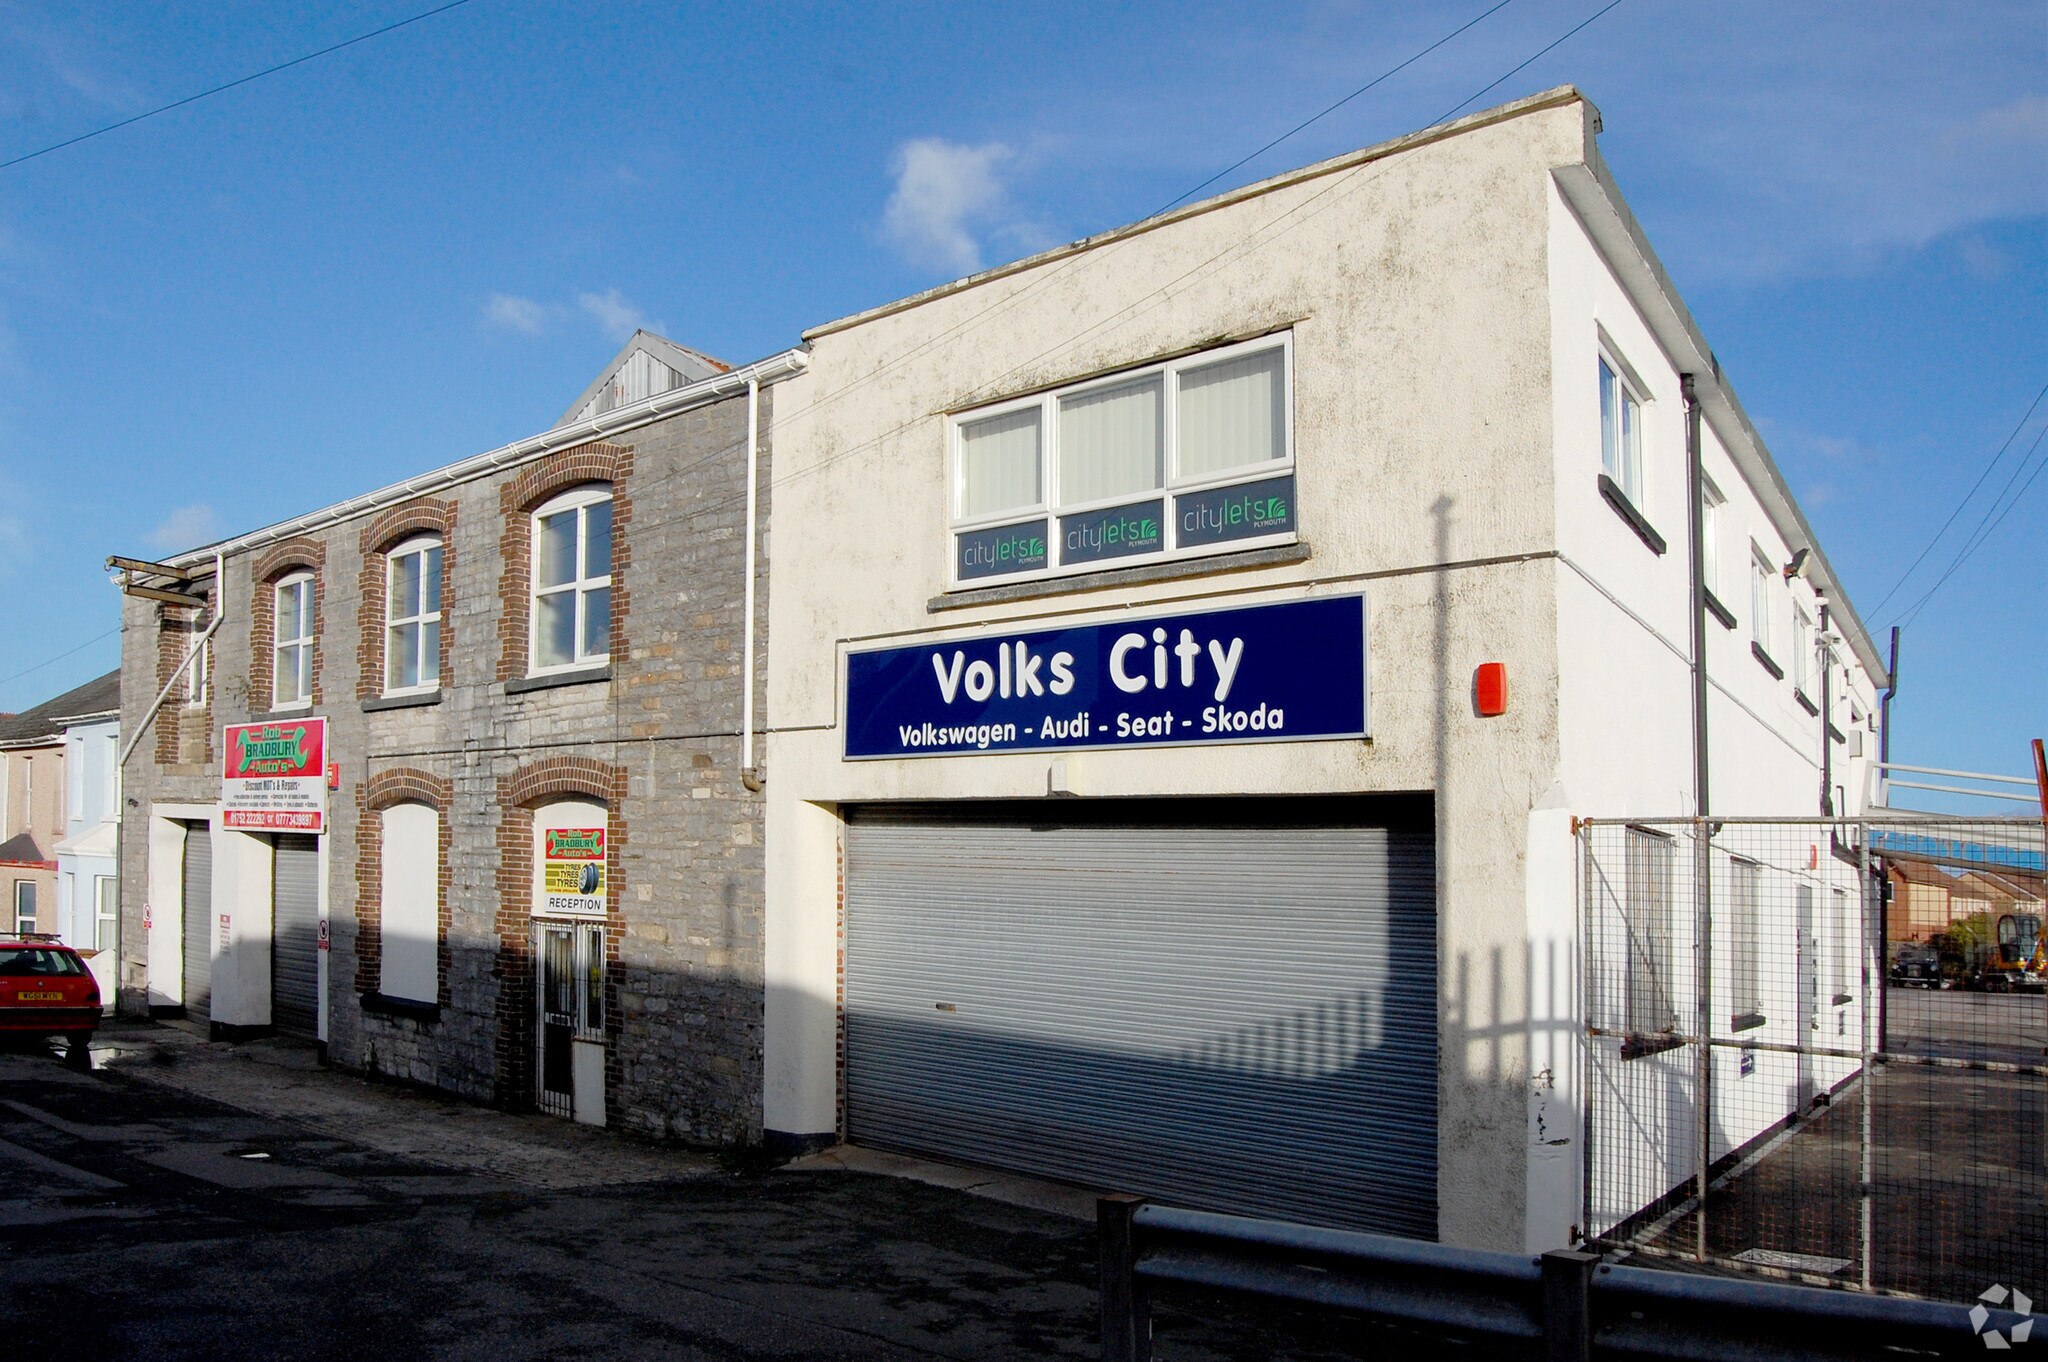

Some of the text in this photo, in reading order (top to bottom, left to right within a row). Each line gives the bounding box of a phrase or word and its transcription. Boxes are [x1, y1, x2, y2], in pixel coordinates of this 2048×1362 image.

[1184, 496, 1266, 535] citylets
[1253, 517, 1287, 529] PLYMOUTH
[1067, 517, 1140, 553] citylets
[1128, 538, 1158, 548] PLYMOUTH
[964, 535, 1029, 569] citylets
[932, 627, 1245, 705] Volks City
[262, 725, 281, 740] Rob
[899, 722, 1016, 749] Volkswagen
[1040, 711, 1090, 740] Audi
[1117, 711, 1174, 738] Seat
[1202, 702, 1285, 734] Skoda
[245, 740, 298, 758] BRADBURY
[256, 760, 289, 773] Auto's
[567, 830, 582, 838] Rob
[555, 839, 594, 848] BRADBURY
[557, 879, 579, 887] TYRES
[549, 898, 601, 910] RECEPTION
